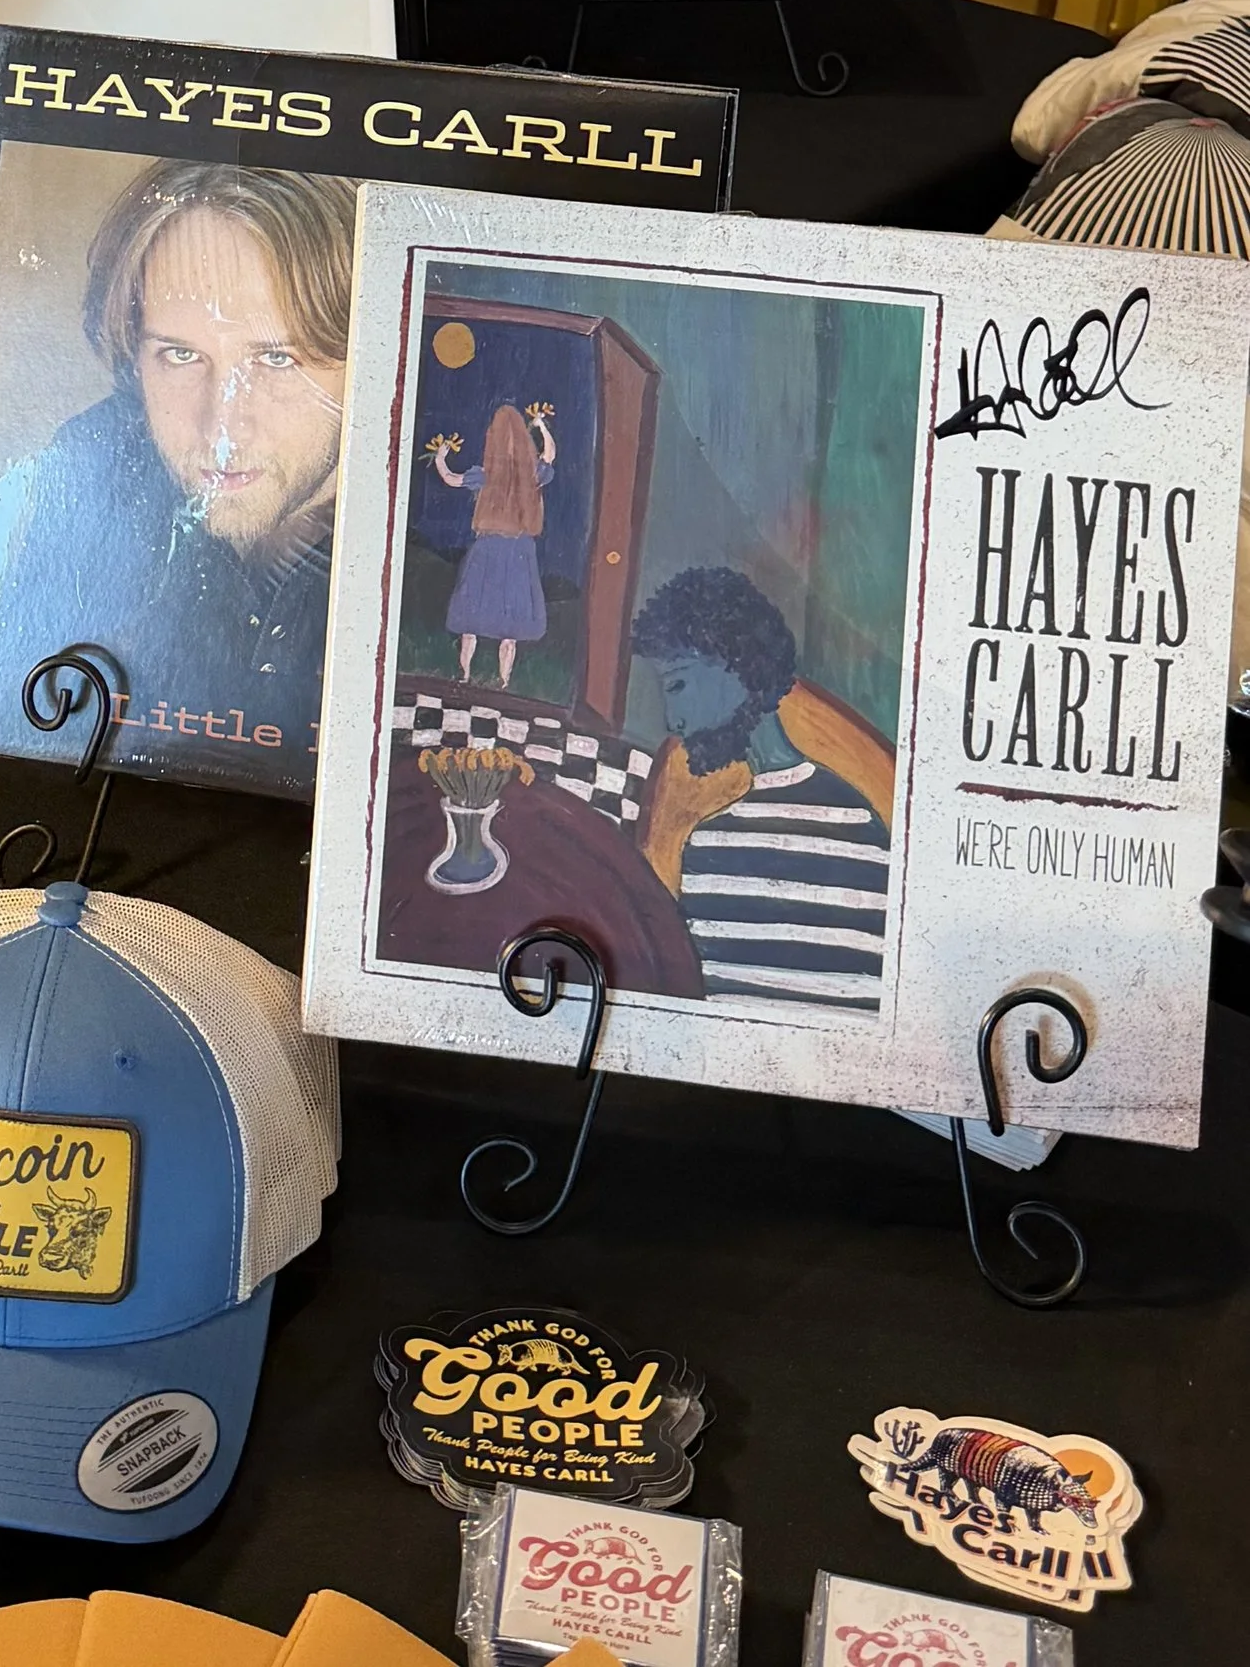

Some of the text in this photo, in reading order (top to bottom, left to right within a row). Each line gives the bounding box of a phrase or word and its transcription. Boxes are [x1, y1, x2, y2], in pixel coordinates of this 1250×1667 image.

[4, 64, 702, 177] HAYES CARLL
[968, 466, 1195, 649] HAYES
[109, 693, 282, 747] Little
[963, 638, 1181, 783] CARLL
[955, 817, 1176, 890] WE'RE ONLY HUMAN
[469, 1319, 617, 1381] THANK GOD FOR
[404, 1338, 662, 1421] Good
[96, 1430, 111, 1445] THE
[115, 1398, 164, 1428] AUTHENTIC
[422, 1427, 656, 1468] Thank People for Being Kind
[472, 1411, 644, 1447] PEOPLE
[117, 1425, 186, 1477] SNAPBACK
[465, 1455, 614, 1483] HAYES CARLL
[885, 1461, 1016, 1535] Hayes
[519, 1536, 694, 1605] Good
[565, 1521, 663, 1572] THANK GOD FOR
[952, 1523, 1070, 1579] Carll
[525, 1599, 558, 1614] Thank
[561, 1606, 598, 1621] People
[599, 1613, 617, 1626] for
[553, 1618, 600, 1634] HAYES
[605, 1628, 652, 1645] CARLL
[560, 1587, 676, 1623] PEOPLE
[883, 1613, 932, 1632] THANK
[939, 1618, 970, 1640] GOD
[968, 1642, 988, 1667] FOR
